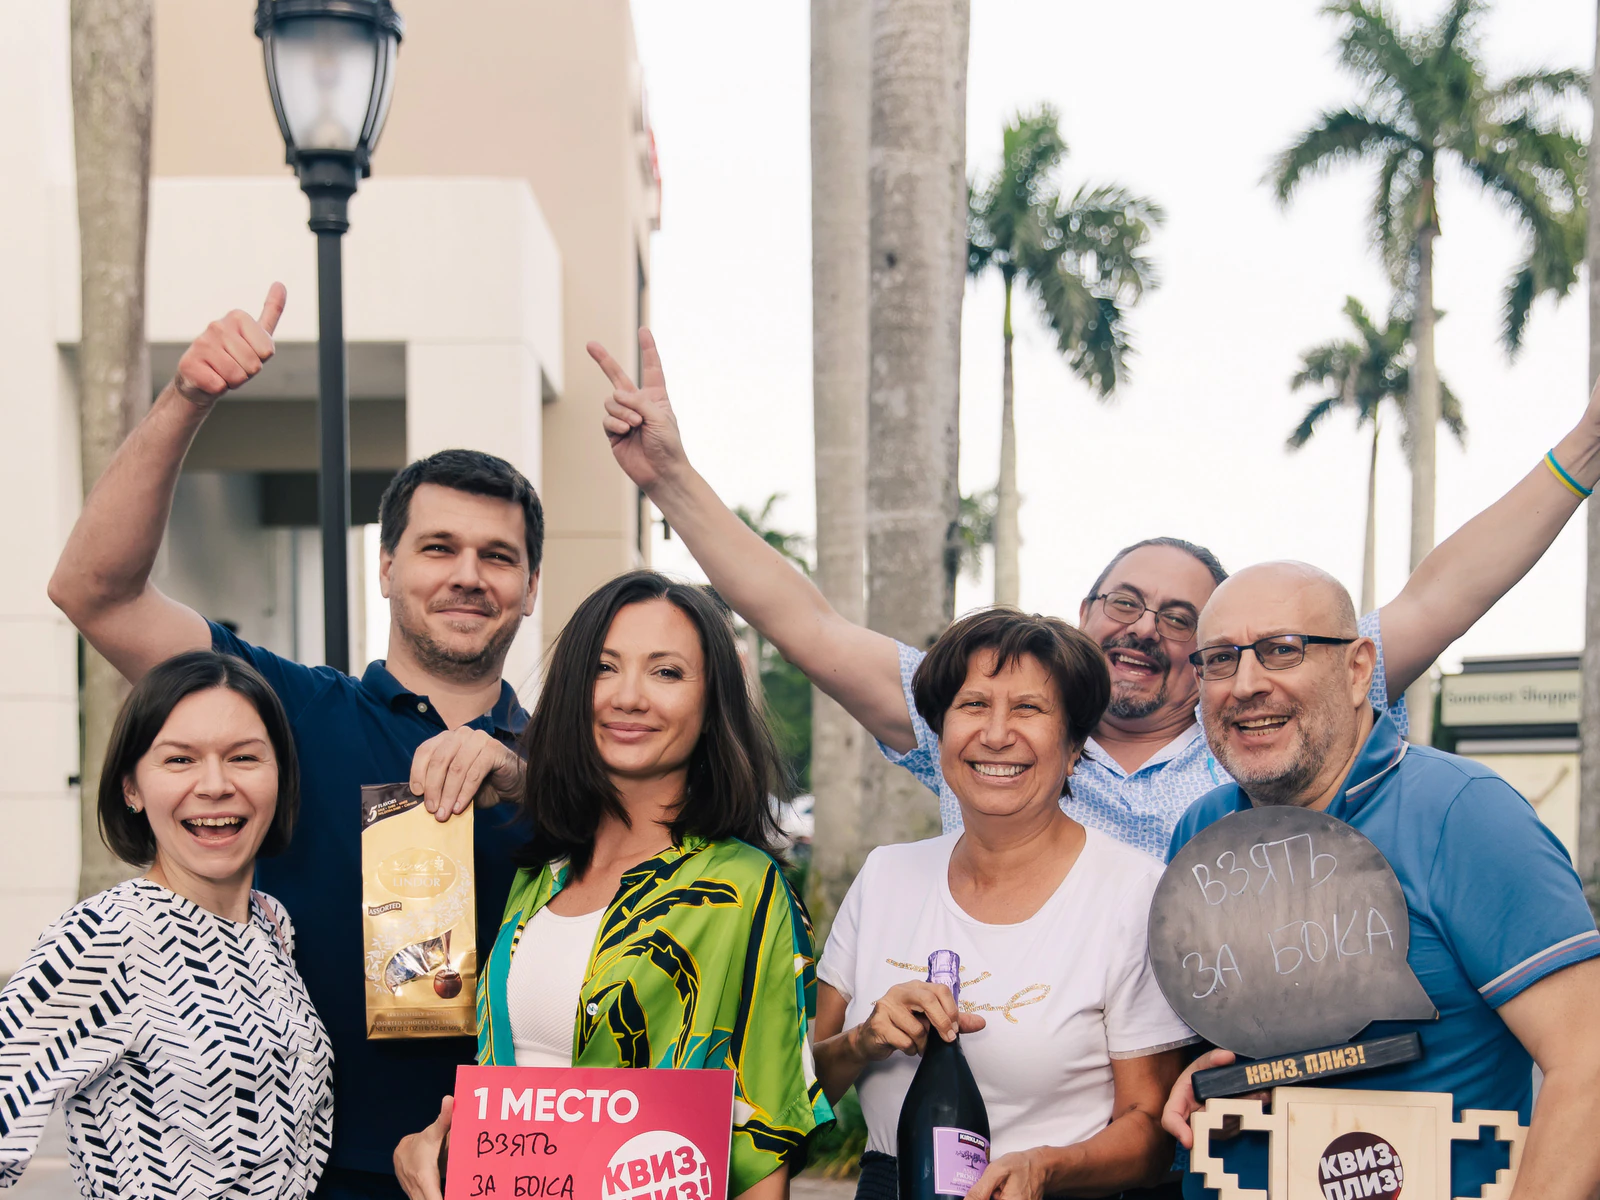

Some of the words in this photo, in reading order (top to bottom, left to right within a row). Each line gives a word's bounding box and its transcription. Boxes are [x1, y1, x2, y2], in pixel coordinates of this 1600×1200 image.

[367, 804, 378, 822] 5
[393, 877, 441, 887] LINDOR
[1191, 833, 1338, 906] ВЗЯТЬ
[368, 902, 401, 915] ASSORTED
[1182, 943, 1243, 999] ЗА
[1268, 906, 1394, 975] БОКА
[1245, 1057, 1303, 1085] КВИЗ,
[1304, 1045, 1366, 1075] ПЛИЗ!
[473, 1087, 490, 1120] 1
[500, 1087, 639, 1124] МЕСТО
[476, 1131, 557, 1158] ВЗЯТЬ
[960, 1133, 985, 1147] KIRKLAND
[605, 1145, 709, 1196] КВИЗ,
[1320, 1142, 1400, 1180] КВИЗ,
[469, 1174, 496, 1197] ЗА
[513, 1174, 575, 1200] БОКА
